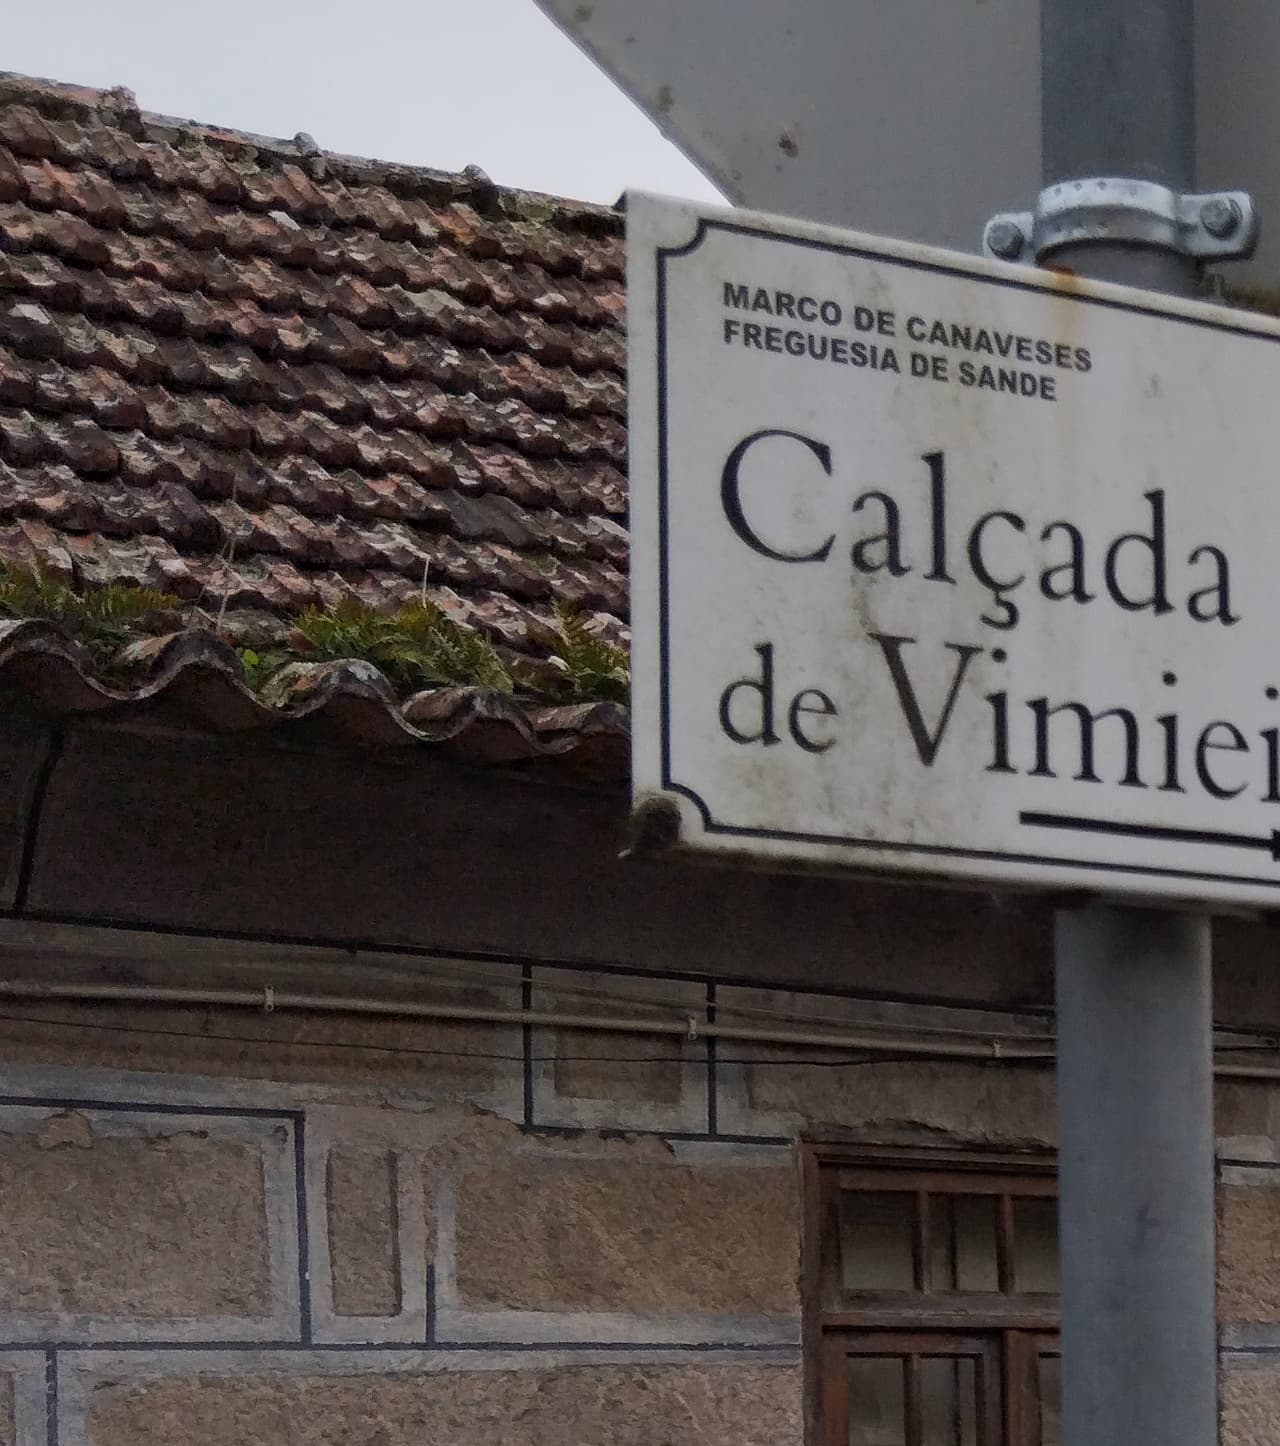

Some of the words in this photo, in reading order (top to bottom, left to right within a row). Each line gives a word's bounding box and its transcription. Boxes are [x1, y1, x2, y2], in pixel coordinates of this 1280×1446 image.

[723, 282, 842, 327] MARCO
[854, 306, 896, 337] DE
[907, 317, 1092, 372] CANAVESES
[724, 319, 901, 375] FREGUESIA
[911, 352, 949, 382] DE
[958, 361, 1057, 402] SANDE
[720, 428, 1241, 630] Calçada
[719, 643, 839, 753] de
